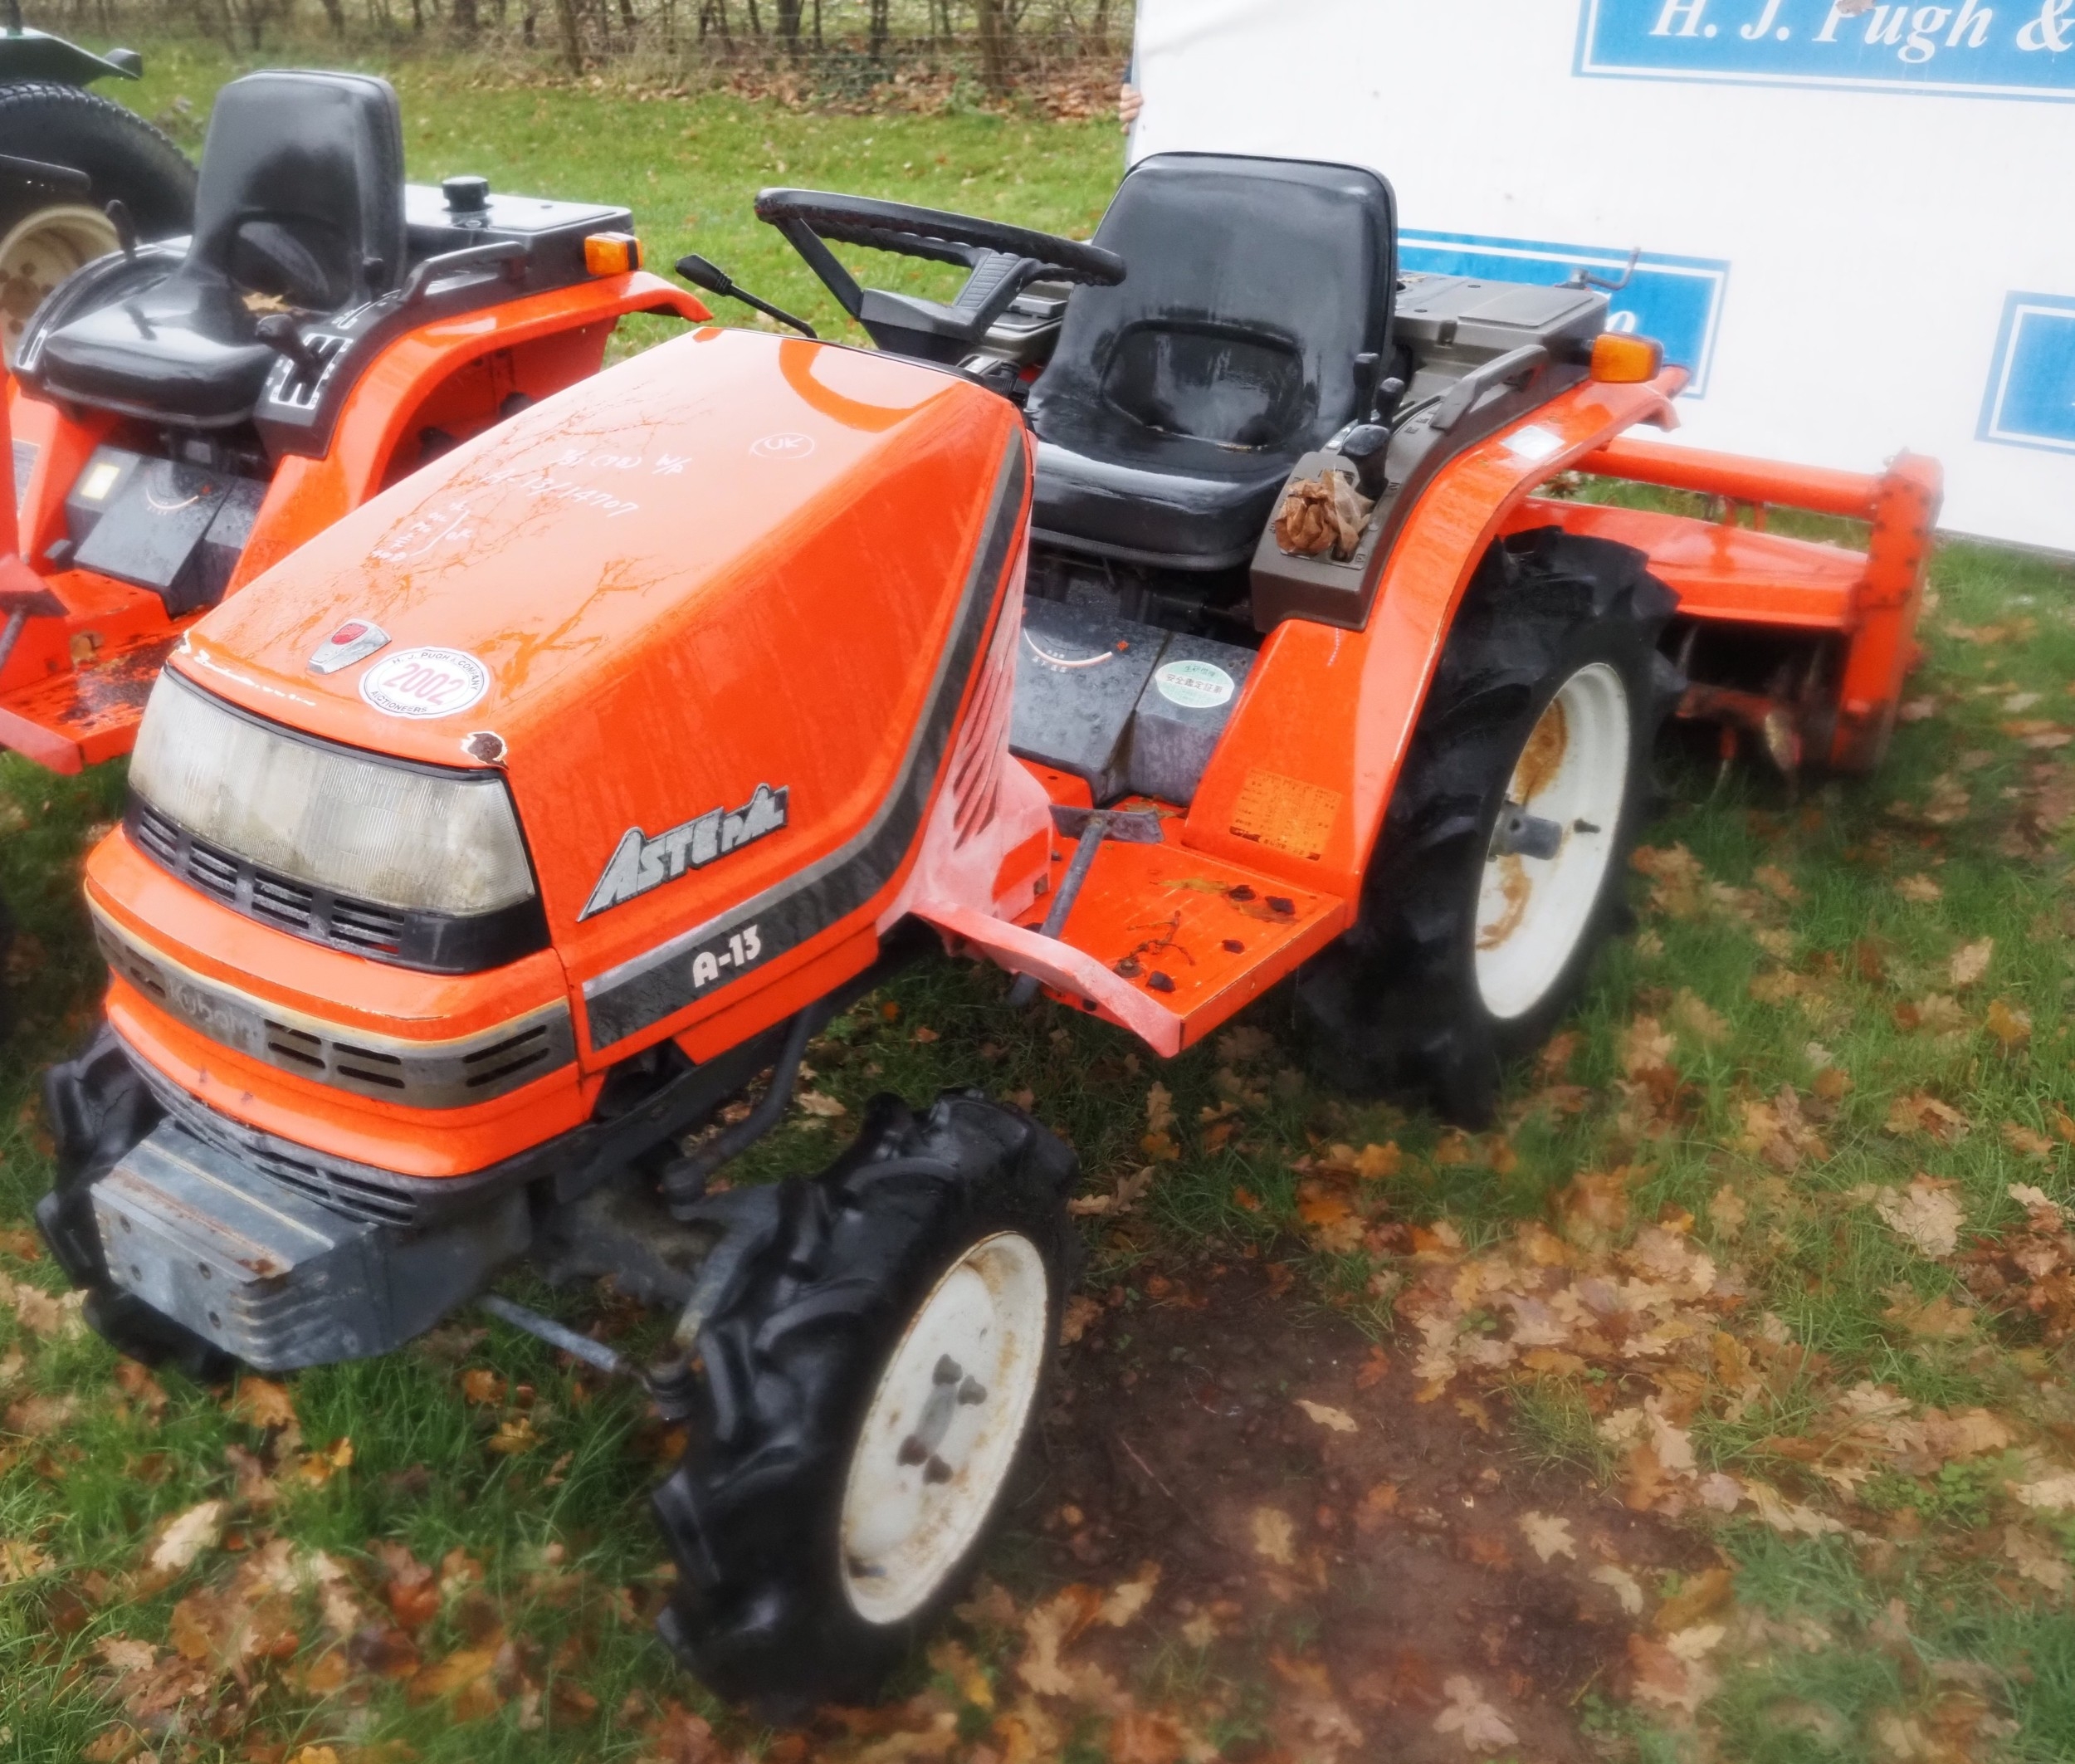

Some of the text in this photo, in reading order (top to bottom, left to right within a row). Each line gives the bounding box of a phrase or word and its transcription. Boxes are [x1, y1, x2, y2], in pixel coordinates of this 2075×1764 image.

[1648, 0, 1717, 38] H.
[1740, 0, 1790, 42] J.
[2015, 0, 2075, 52] &
[421, 652, 452, 661] PUGH
[382, 662, 466, 706] 2002
[692, 924, 762, 989] A-13
